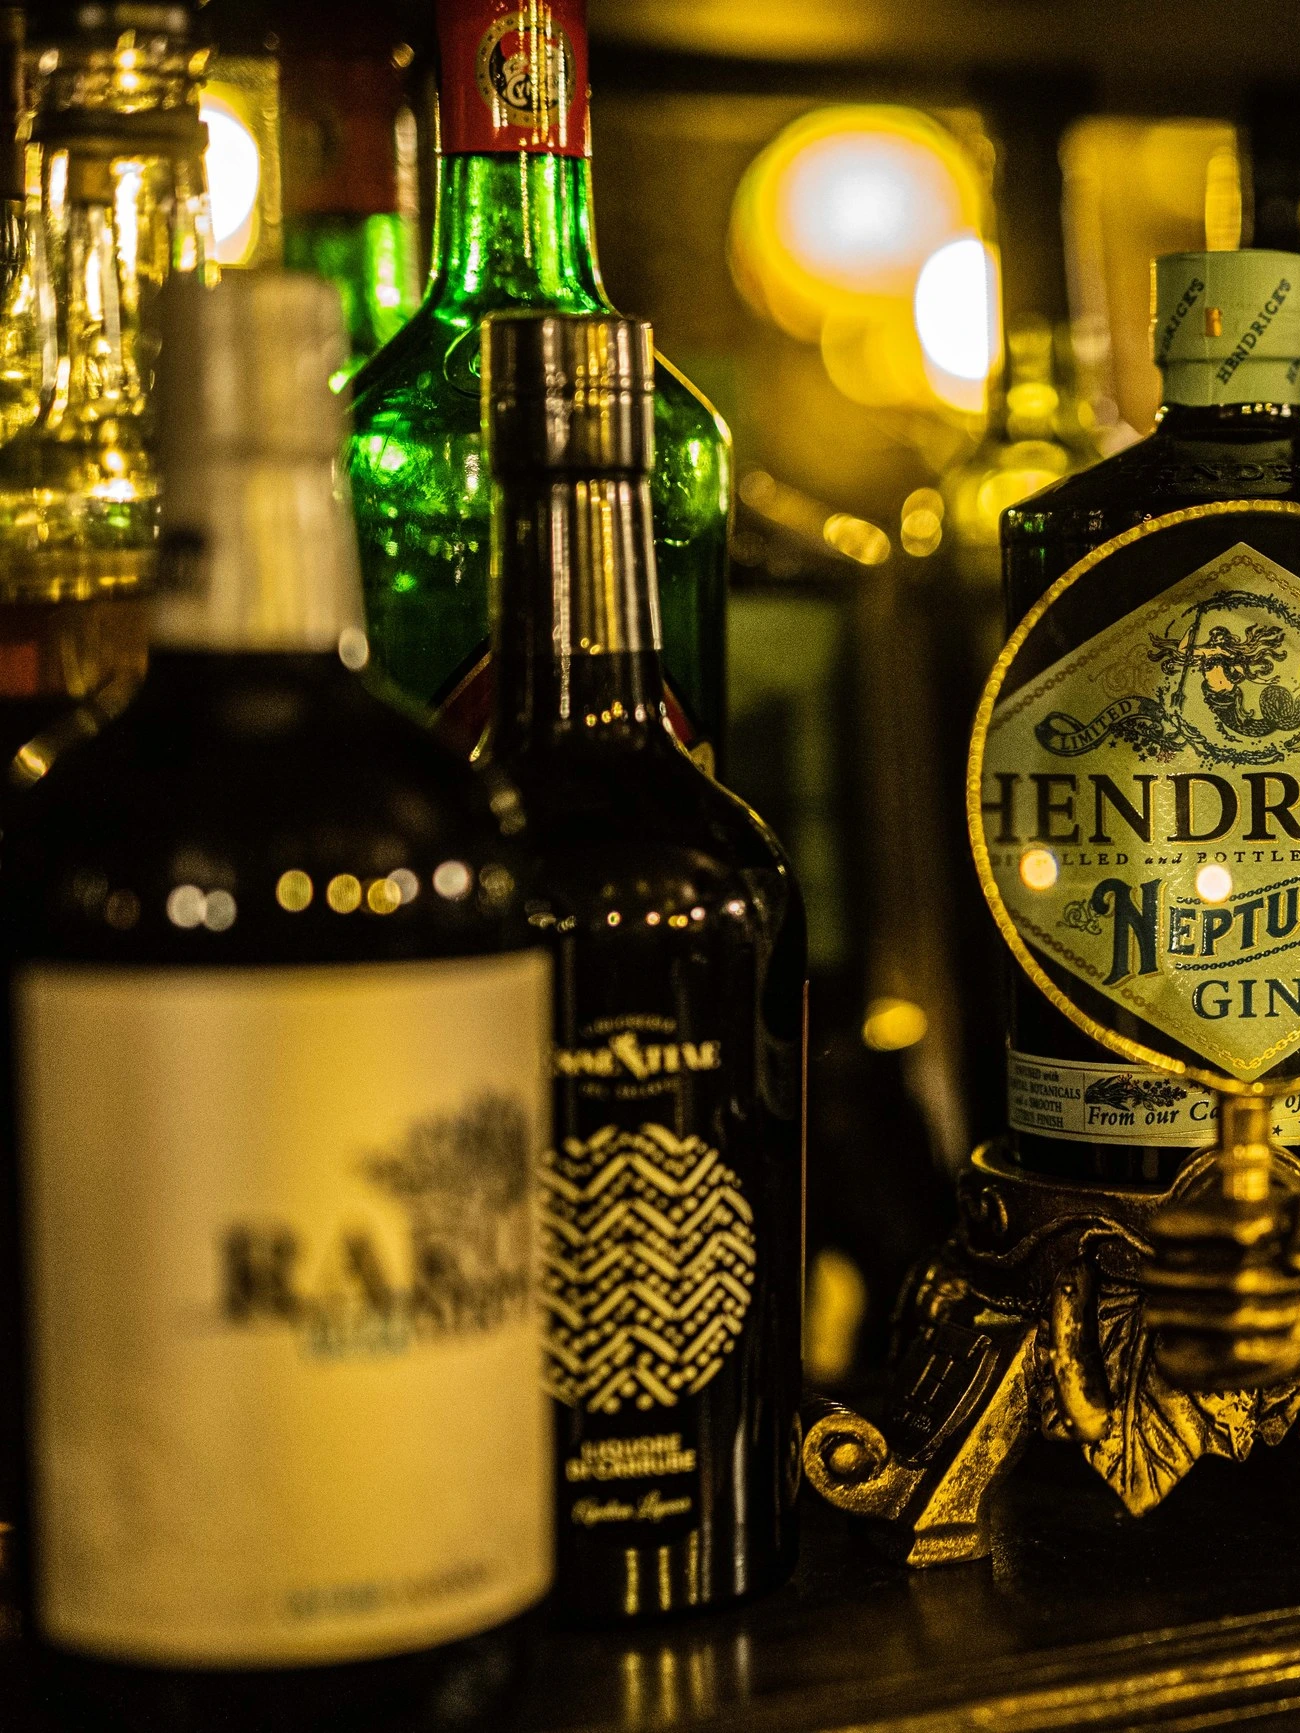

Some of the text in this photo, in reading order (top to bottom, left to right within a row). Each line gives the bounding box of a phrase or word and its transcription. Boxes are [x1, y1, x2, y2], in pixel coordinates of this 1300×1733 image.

[1060, 699, 1133, 751] LIMITED
[1144, 852, 1183, 866] and
[1087, 1105, 1136, 1127] From
[1144, 1108, 1181, 1125] our
